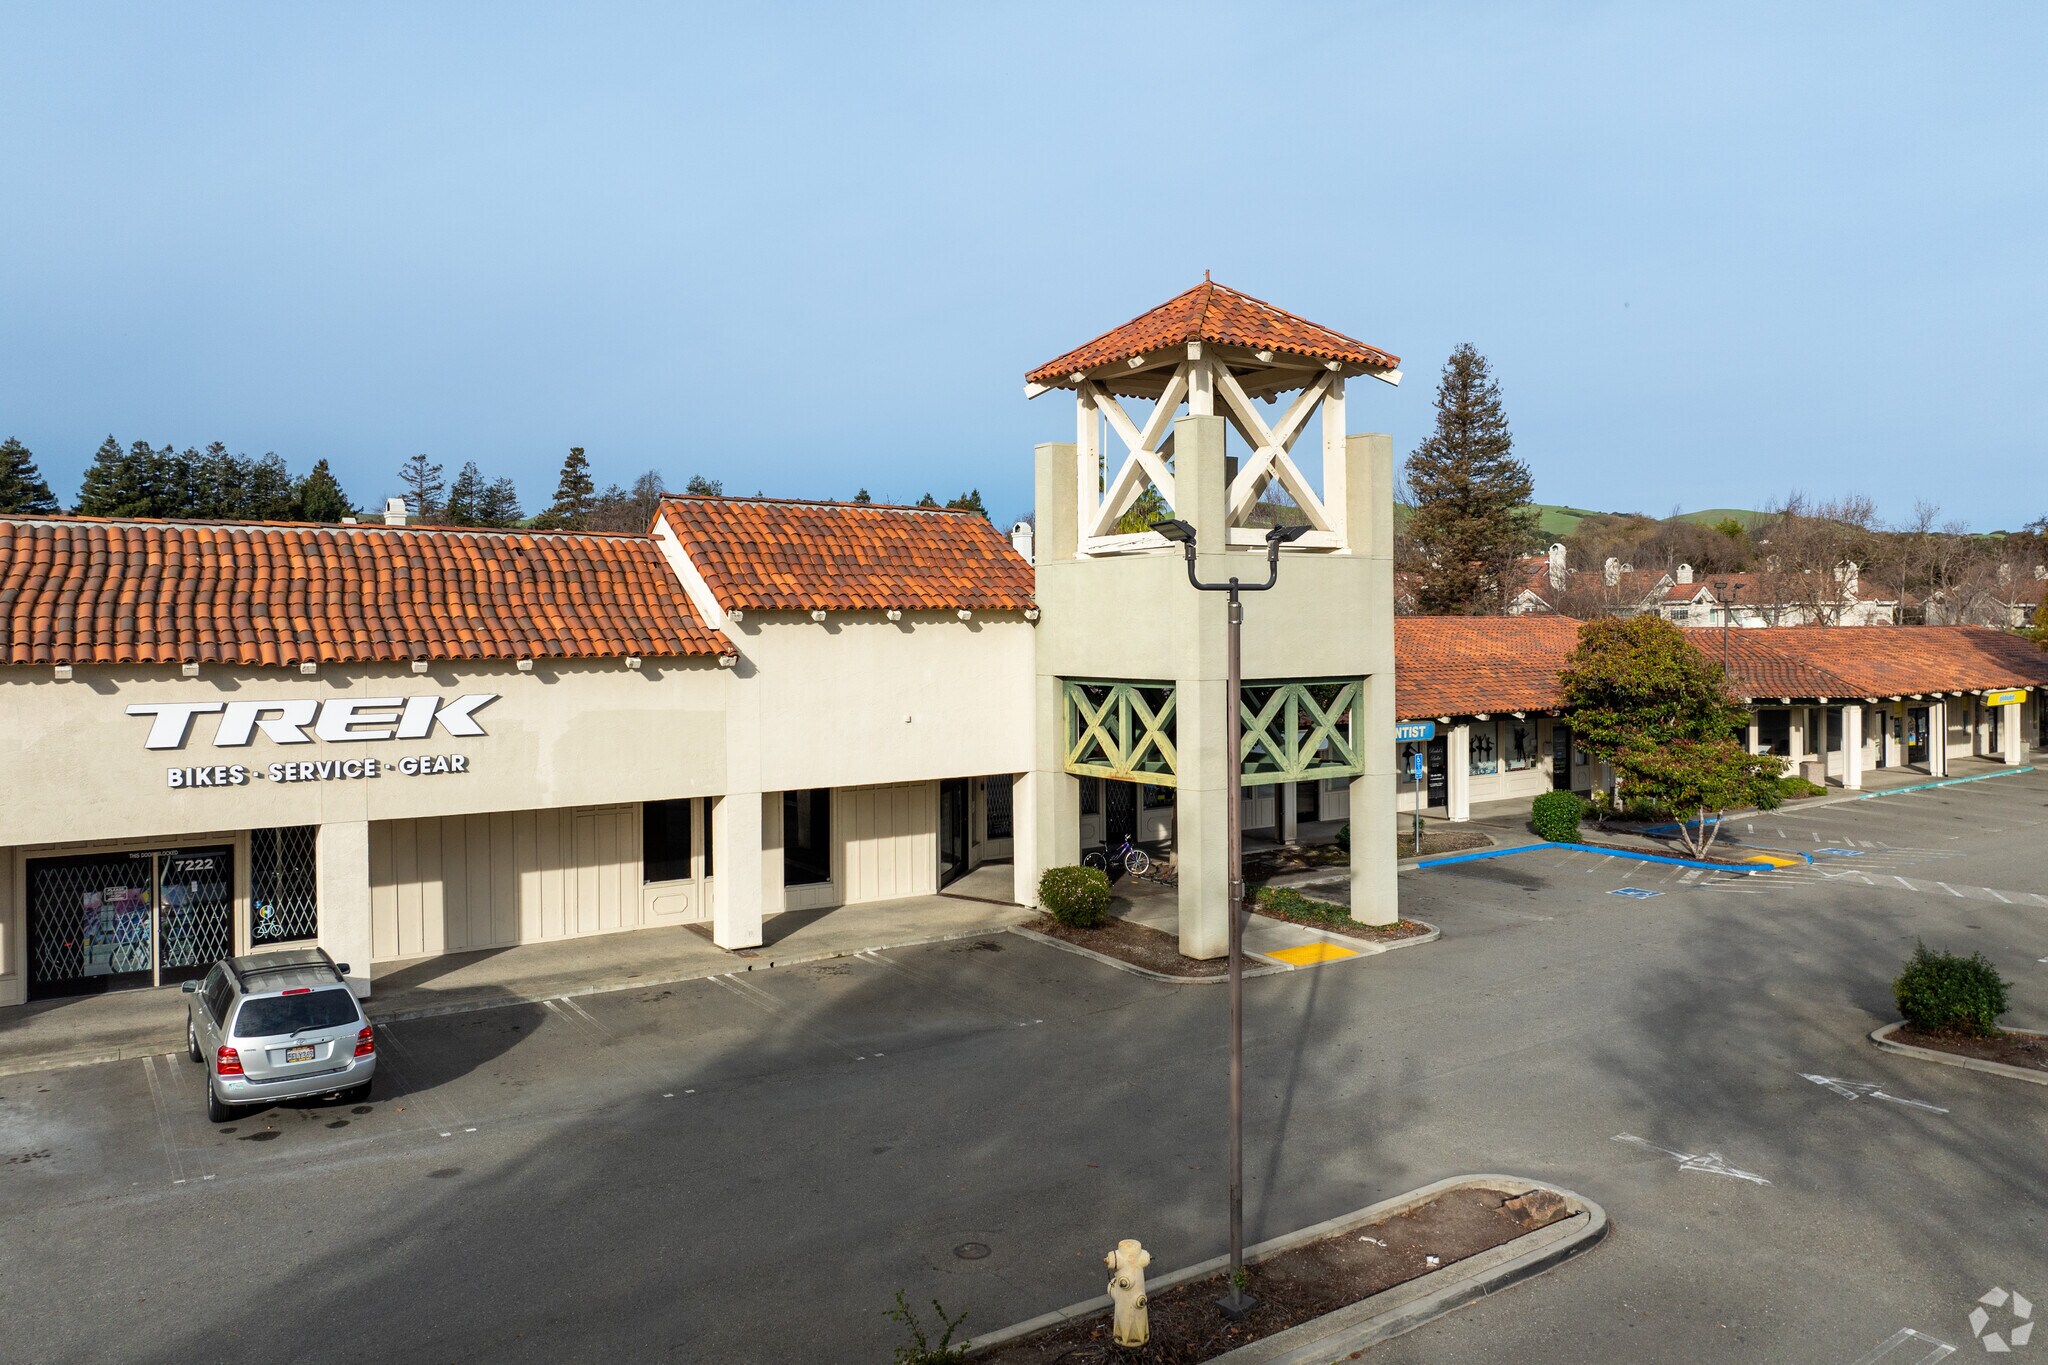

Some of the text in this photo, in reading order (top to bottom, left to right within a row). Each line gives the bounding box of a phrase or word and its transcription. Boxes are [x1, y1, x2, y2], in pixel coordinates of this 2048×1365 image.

[125, 694, 501, 750] TREK
[167, 754, 466, 788] BIKES SERVICE GEAR
[175, 858, 214, 872] 7222
